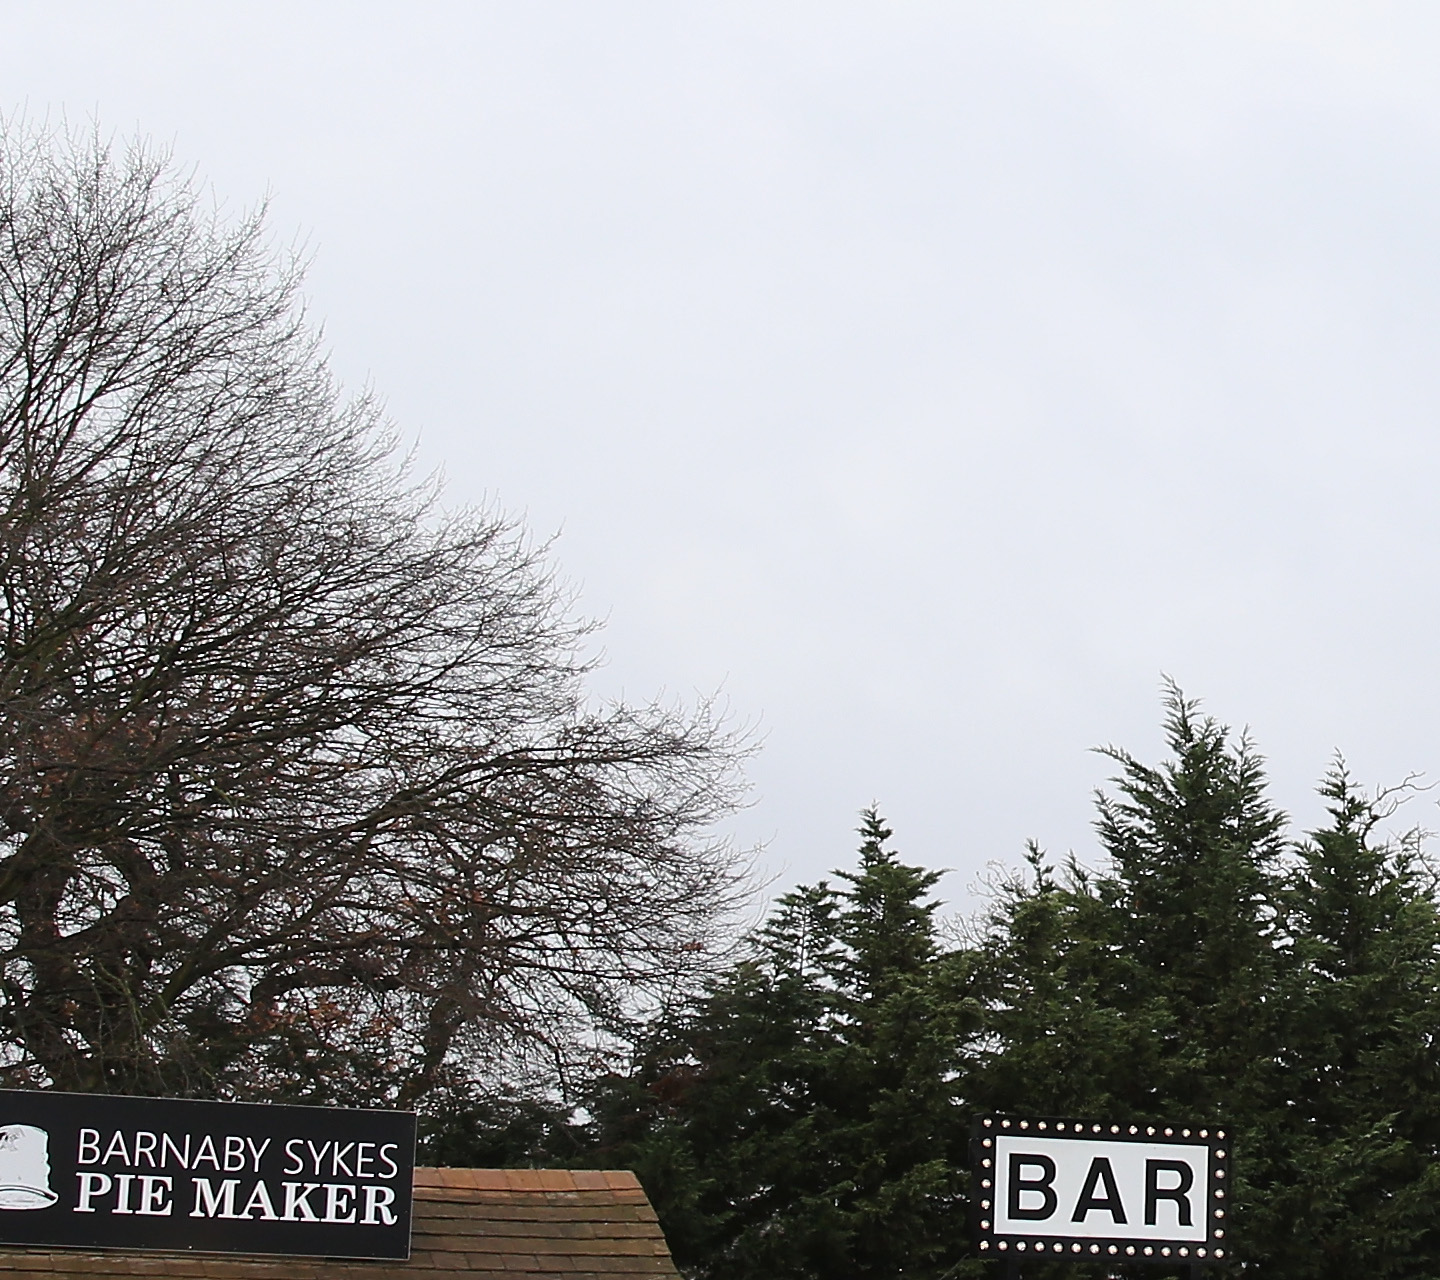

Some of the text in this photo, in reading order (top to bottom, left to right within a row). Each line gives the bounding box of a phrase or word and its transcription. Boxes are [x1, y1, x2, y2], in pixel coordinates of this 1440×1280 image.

[78, 1128, 398, 1179] BARNABY SYKES
[73, 1172, 398, 1225] PIE MAKER
[1008, 1153, 1194, 1227] BAR
